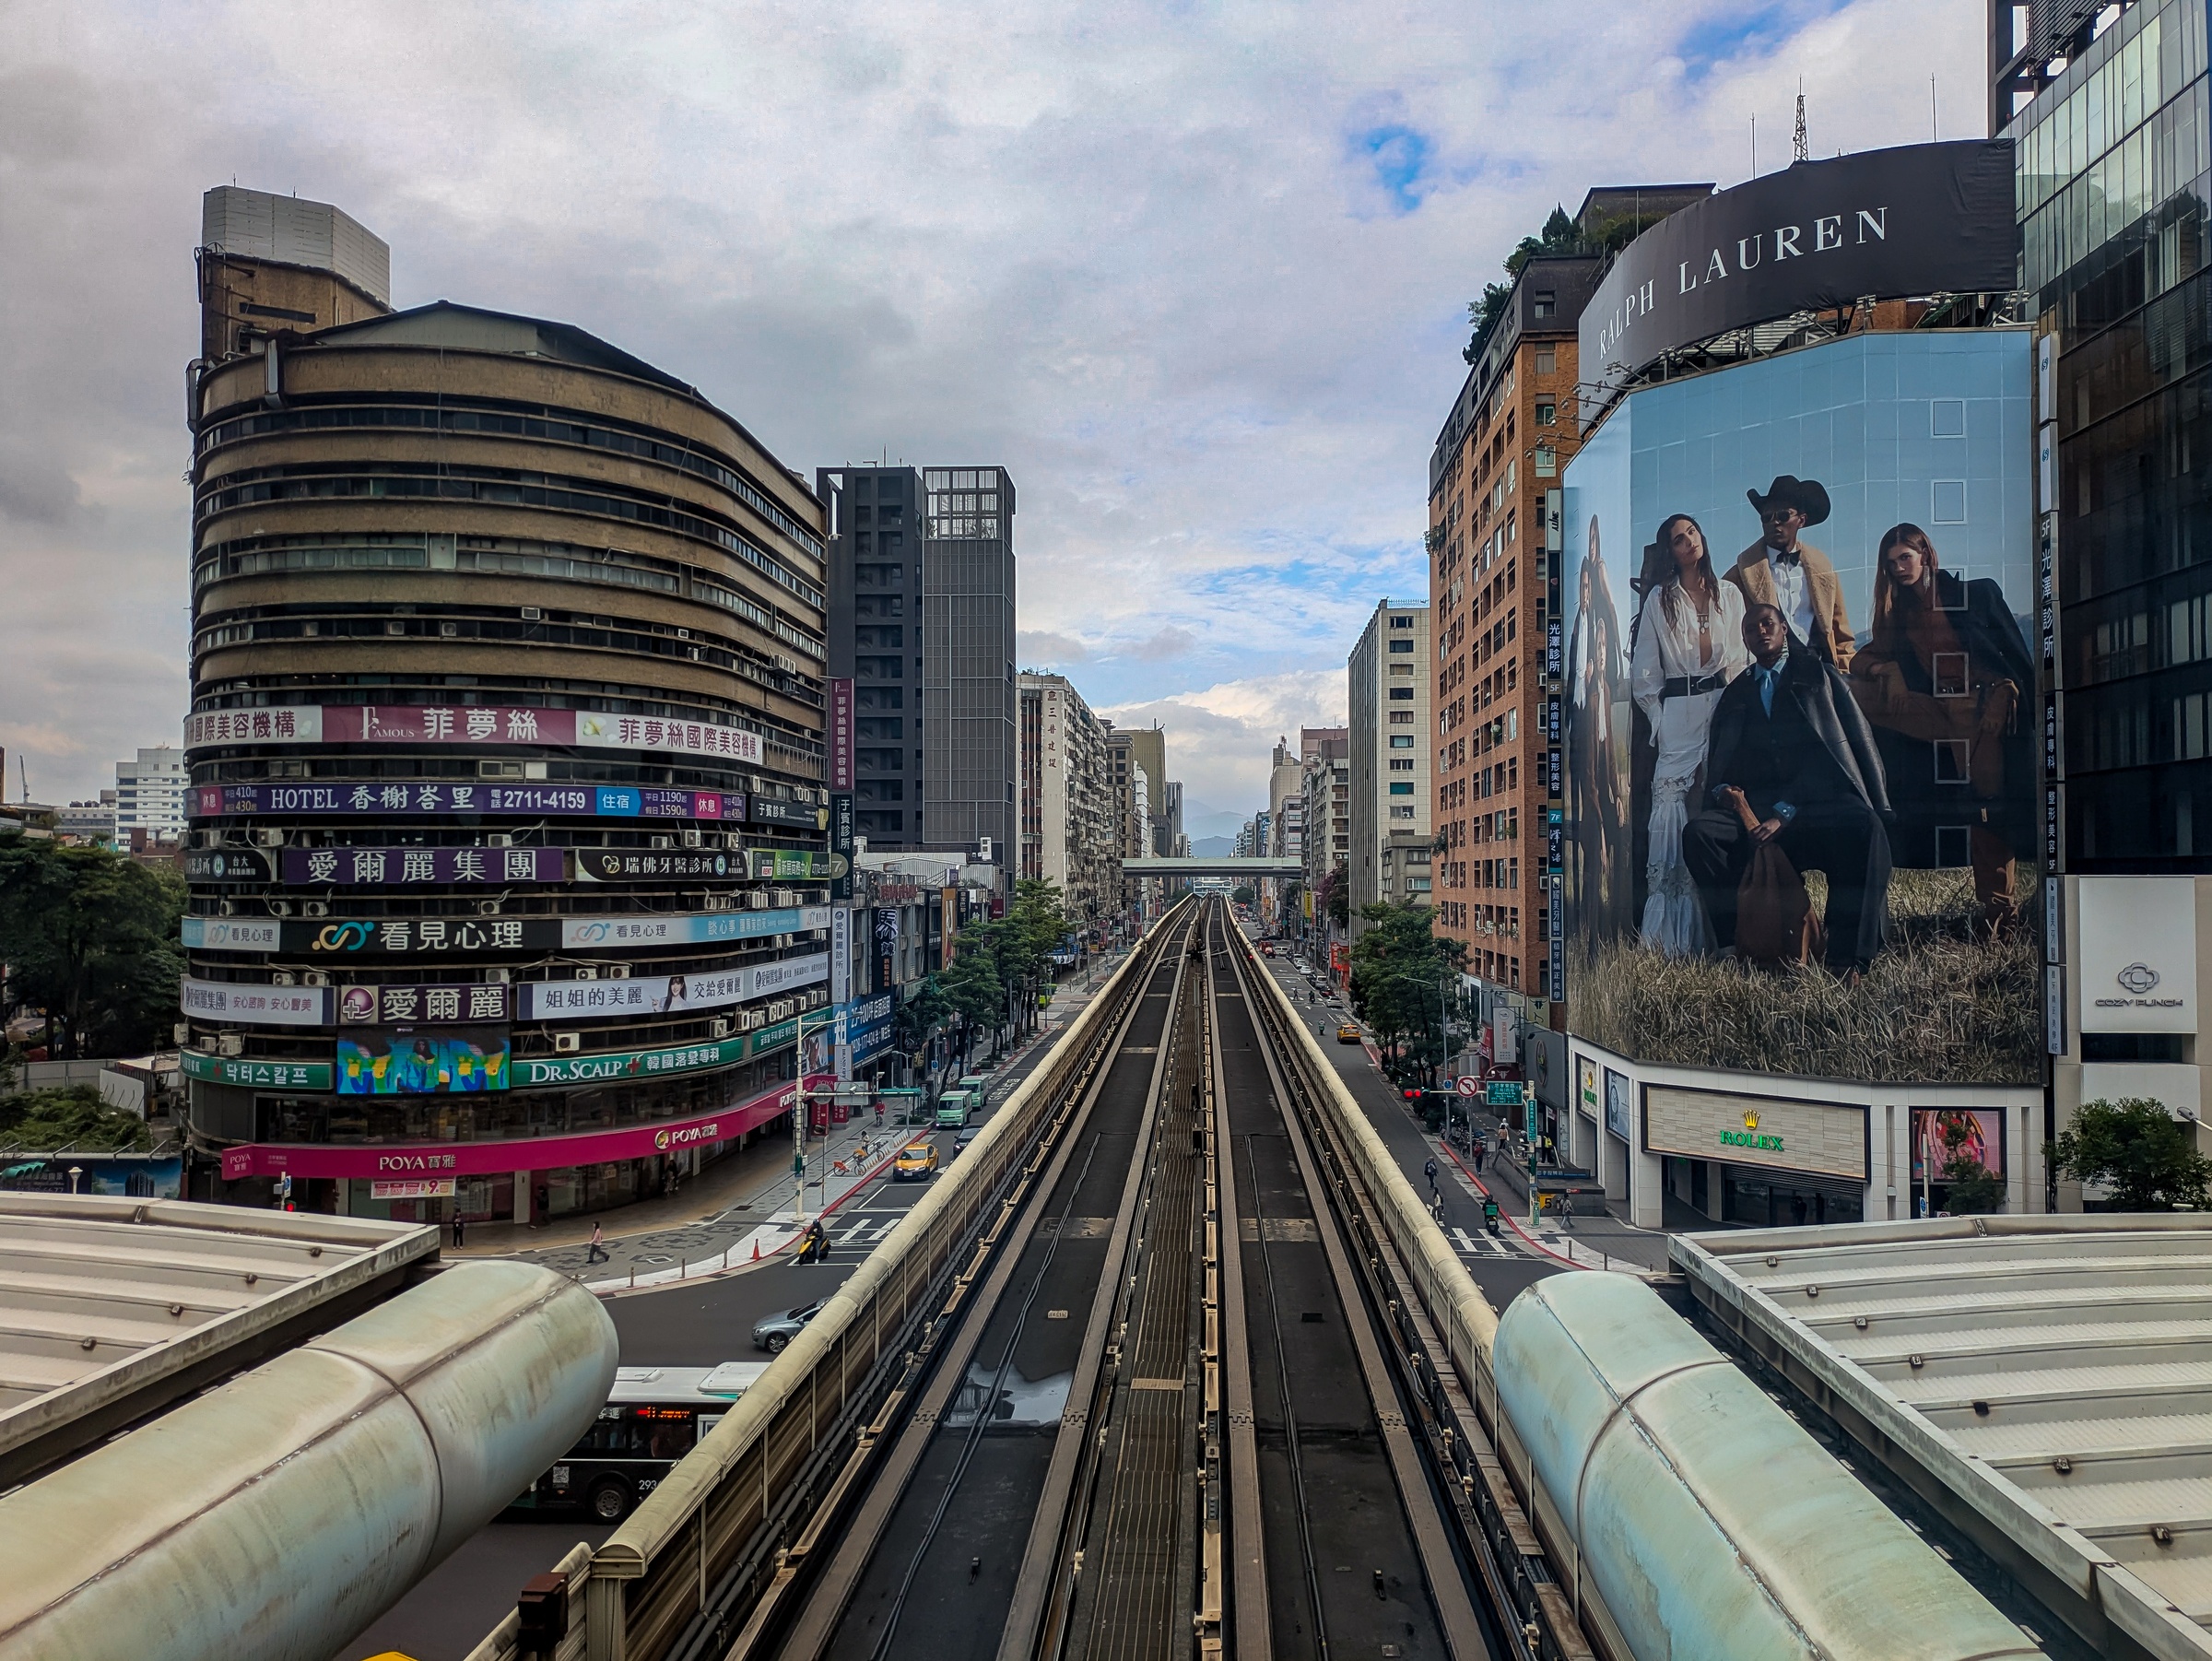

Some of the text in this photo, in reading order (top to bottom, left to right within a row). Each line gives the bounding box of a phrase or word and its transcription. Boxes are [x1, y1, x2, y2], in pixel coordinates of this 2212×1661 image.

[1599, 206, 1888, 360] RALPH LAUREN
[2041, 518, 2051, 538] 5F
[2041, 548, 2053, 659] 光澤診所
[1548, 623, 1560, 673] 光澤診所
[1549, 684, 1560, 692] 5F
[422, 707, 539, 741] 菲夢絲
[1549, 701, 1559, 740] 皮膚專科
[618, 717, 758, 760] 菲夢絲國際美容機構
[837, 696, 847, 786] 菲夢絲國際美容機構
[2046, 705, 2055, 771] 皮膚專科
[1550, 752, 1560, 791] 整形美容
[203, 794, 217, 808] 休息
[270, 784, 476, 810] HOTEL 香榭峇里
[490, 789, 586, 809] 電話 2711-4159
[602, 794, 630, 809] 住宿
[645, 791, 688, 803] 平日 1190起
[698, 798, 716, 813] 休息
[645, 804, 688, 816] 假日 1590起
[758, 803, 786, 819] 于賓診所
[1550, 813, 1560, 822] 7F
[840, 799, 850, 850] 于賓診所
[232, 855, 249, 867] 台大
[307, 850, 536, 884] 愛爾麗集團
[624, 855, 712, 874] 瑞佛牙醫診所
[231, 927, 274, 942] 看見心理
[379, 921, 524, 951] 看見心理
[616, 923, 667, 939] 看見心理
[708, 919, 735, 936] 談心事
[835, 922, 844, 969] 愛爾麗診所
[545, 976, 742, 1009] 姐姐的美麗 交給愛爾麗
[233, 995, 312, 1012] 安心諮詢 安心醫美
[382, 985, 505, 1021] 愛爾麗
[834, 1009, 847, 1045] 租
[646, 1047, 721, 1072] 韓國落髮專科
[226, 1063, 309, 1085] 닥터스칼프
[672, 1126, 703, 1145] POYA
[1719, 1129, 1785, 1151] ROLEX
[229, 1153, 252, 1165] POYA
[379, 1153, 457, 1171] POYA 寶雅
[1544, 1197, 1552, 1209] 5
[638, 1479, 663, 1490] 293
